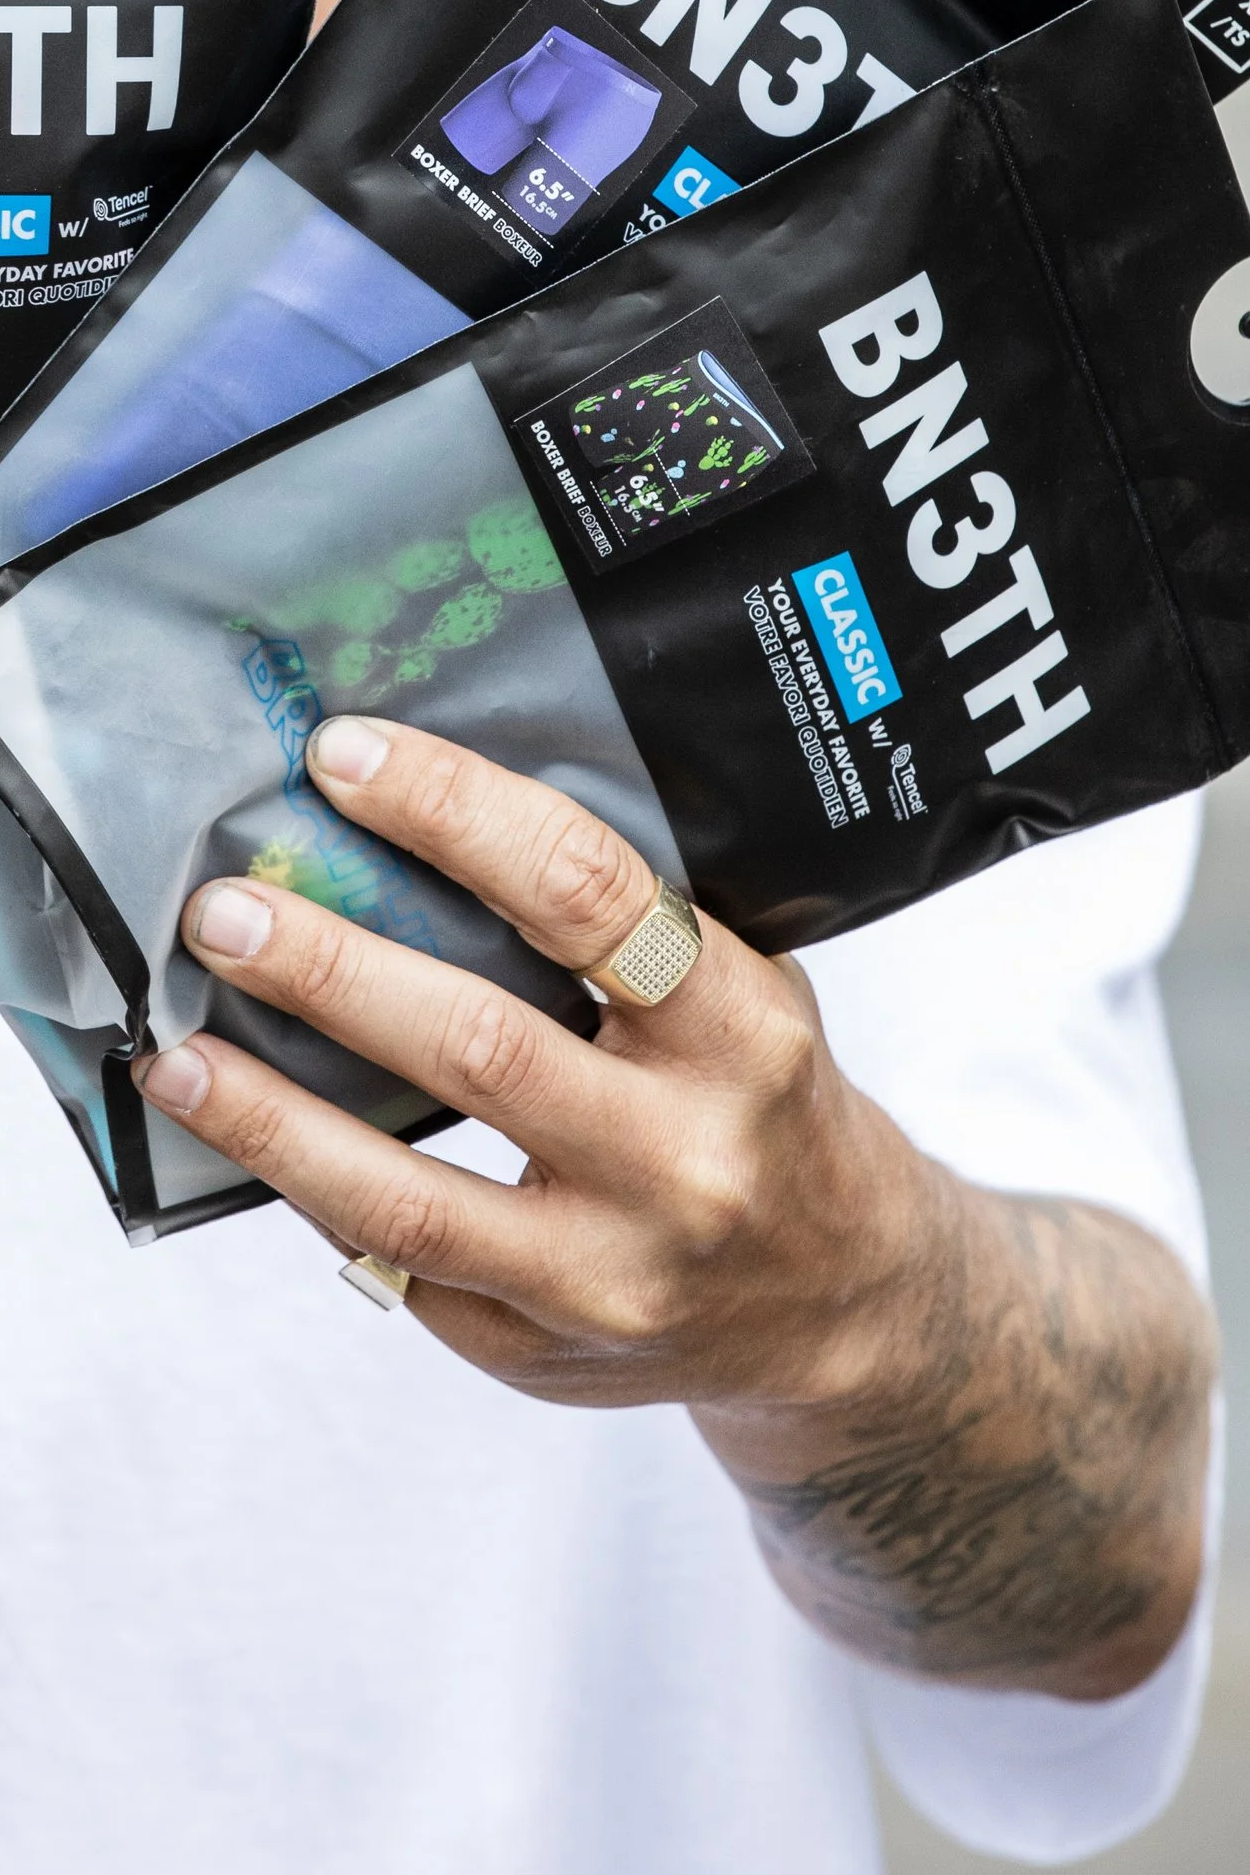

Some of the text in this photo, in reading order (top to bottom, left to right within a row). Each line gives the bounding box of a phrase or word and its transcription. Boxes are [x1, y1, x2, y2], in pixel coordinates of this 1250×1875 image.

[410, 144, 543, 268] BOXER BRIEF BOXEUR
[673, 167, 729, 210] CL
[530, 420, 613, 558] BOXER BRIEF BOXEUR
[818, 270, 1092, 775] BN3TH
[768, 577, 871, 820] YOUR EVERYDAY FAVORITE
[813, 568, 887, 706] CLASSIC
[744, 584, 849, 830] VOTRE FAVORI QUOTIDIEN
